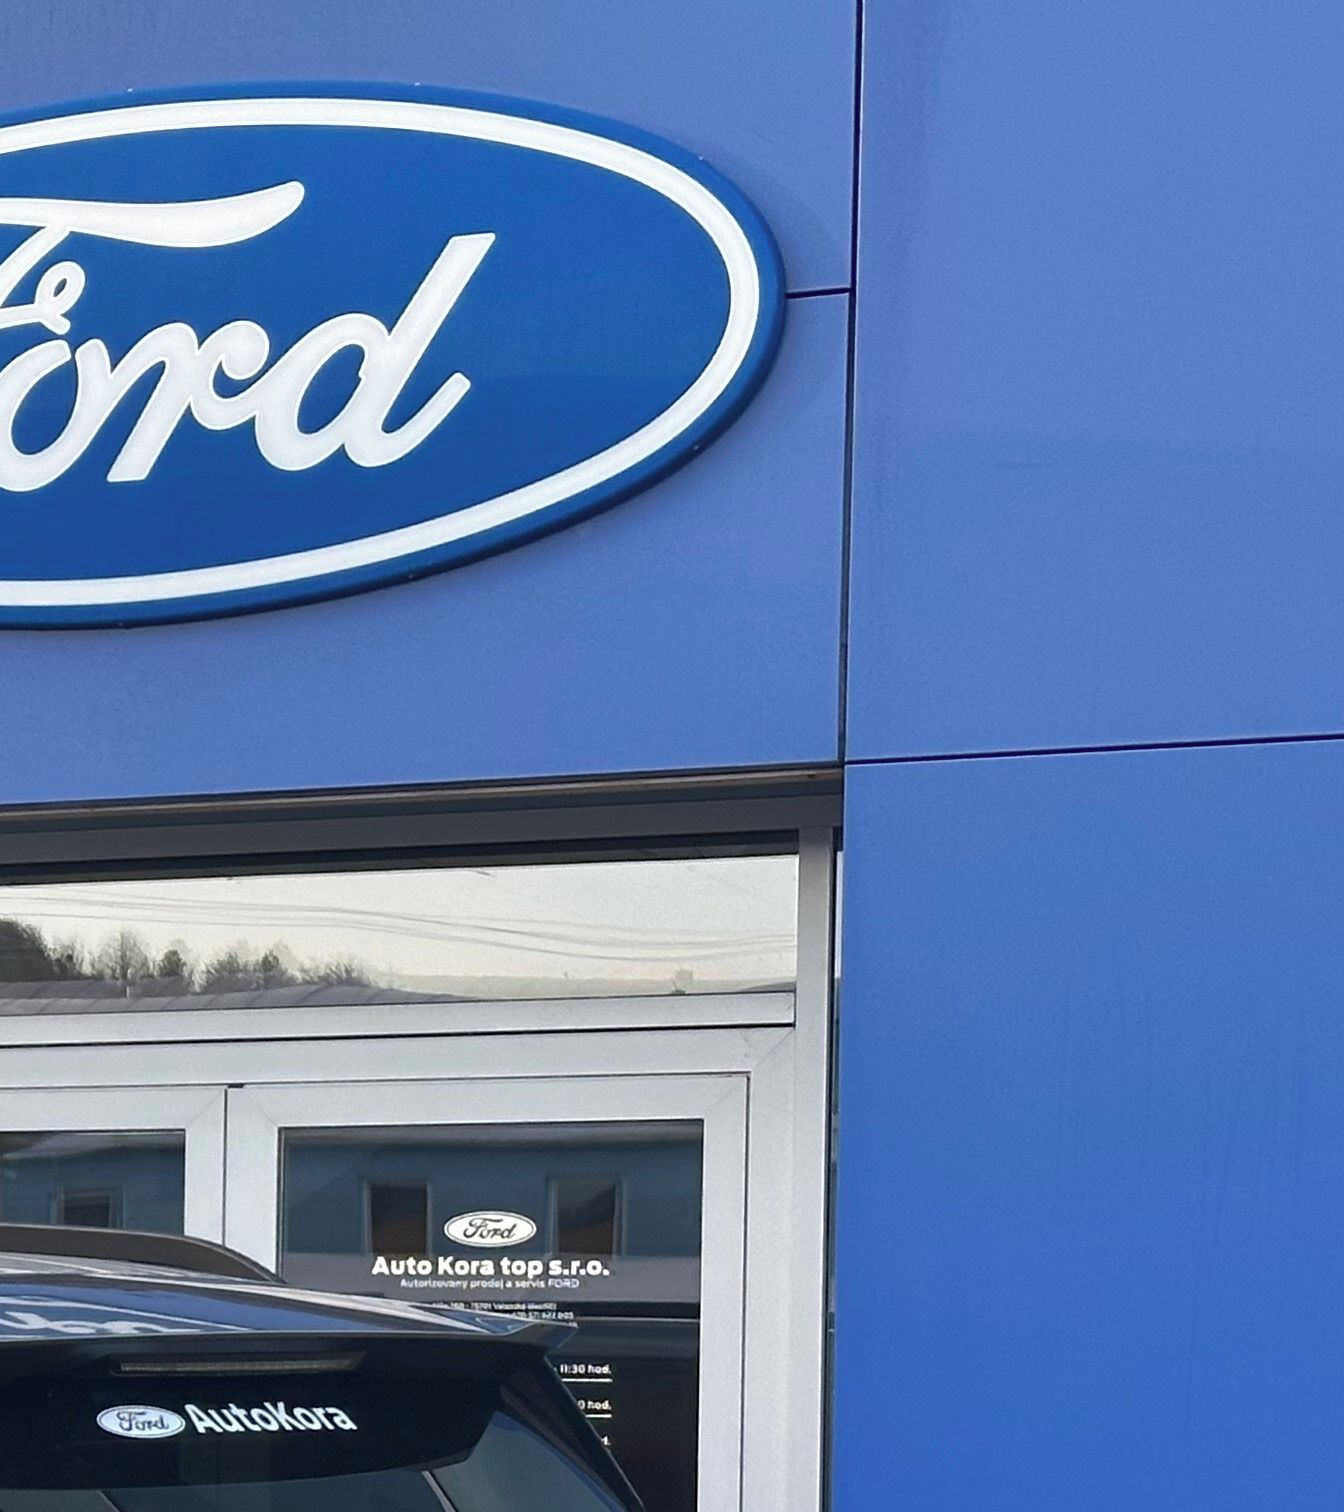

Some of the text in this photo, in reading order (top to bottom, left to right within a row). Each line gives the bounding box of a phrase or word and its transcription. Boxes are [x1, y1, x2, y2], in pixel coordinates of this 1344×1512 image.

[462, 1217, 517, 1242] Ford
[371, 1256, 610, 1279] Auto Kora top s.r.o.
[470, 1278, 504, 1290] prodej
[505, 1280, 512, 1289] a
[515, 1278, 545, 1289] servis
[548, 1278, 580, 1289] FORD
[560, 1364, 612, 1374] 11:30 hod.
[587, 1400, 612, 1410] hod.
[116, 1402, 358, 1434] Ford AutoKora
